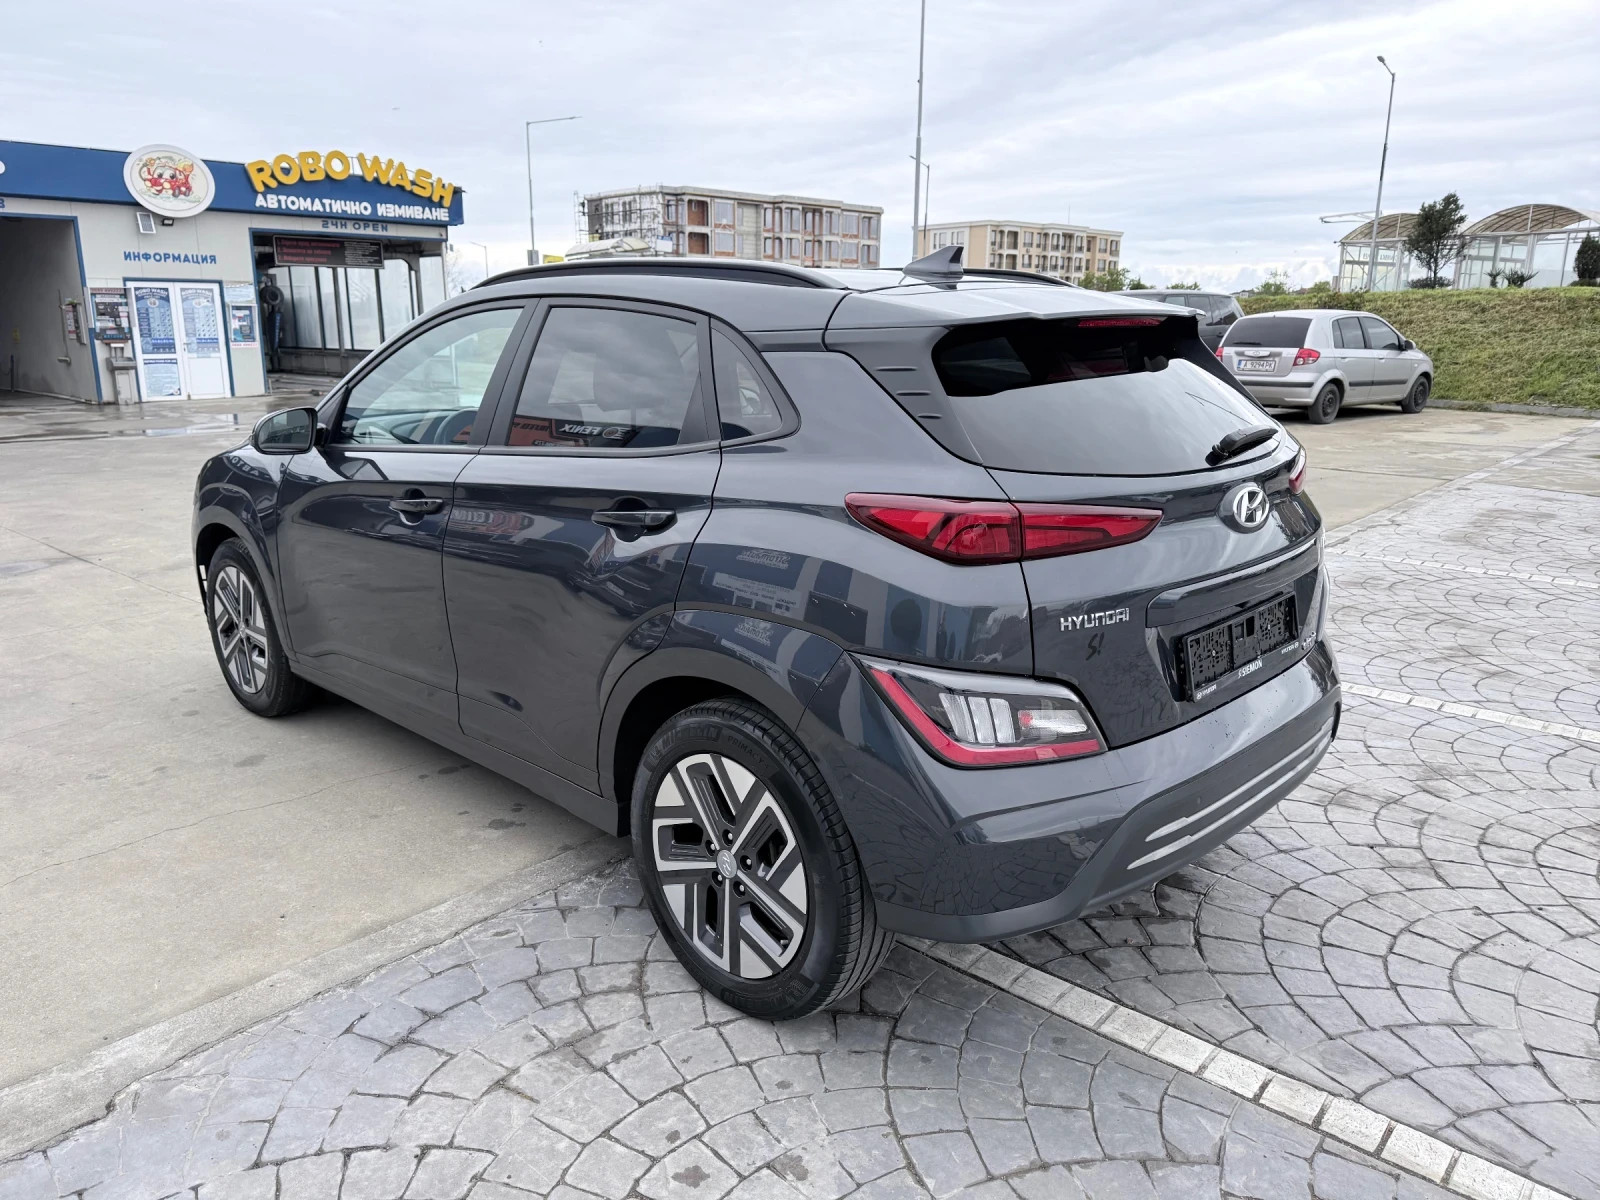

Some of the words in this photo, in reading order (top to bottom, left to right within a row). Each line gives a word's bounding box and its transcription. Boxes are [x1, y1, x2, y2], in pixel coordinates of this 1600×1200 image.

[244, 150, 351, 193] ROBO
[357, 152, 454, 207] WASH
[255, 193, 372, 215] АВТОМАТИЧНО
[376, 203, 449, 221] ИЗМИВАНЕ
[352, 222, 389, 233] OPEN
[123, 251, 217, 264] ИНФОРМАЦИЯ
[1060, 607, 1130, 632] HYUNDAI
[728, 735, 764, 763] PRIMACY
